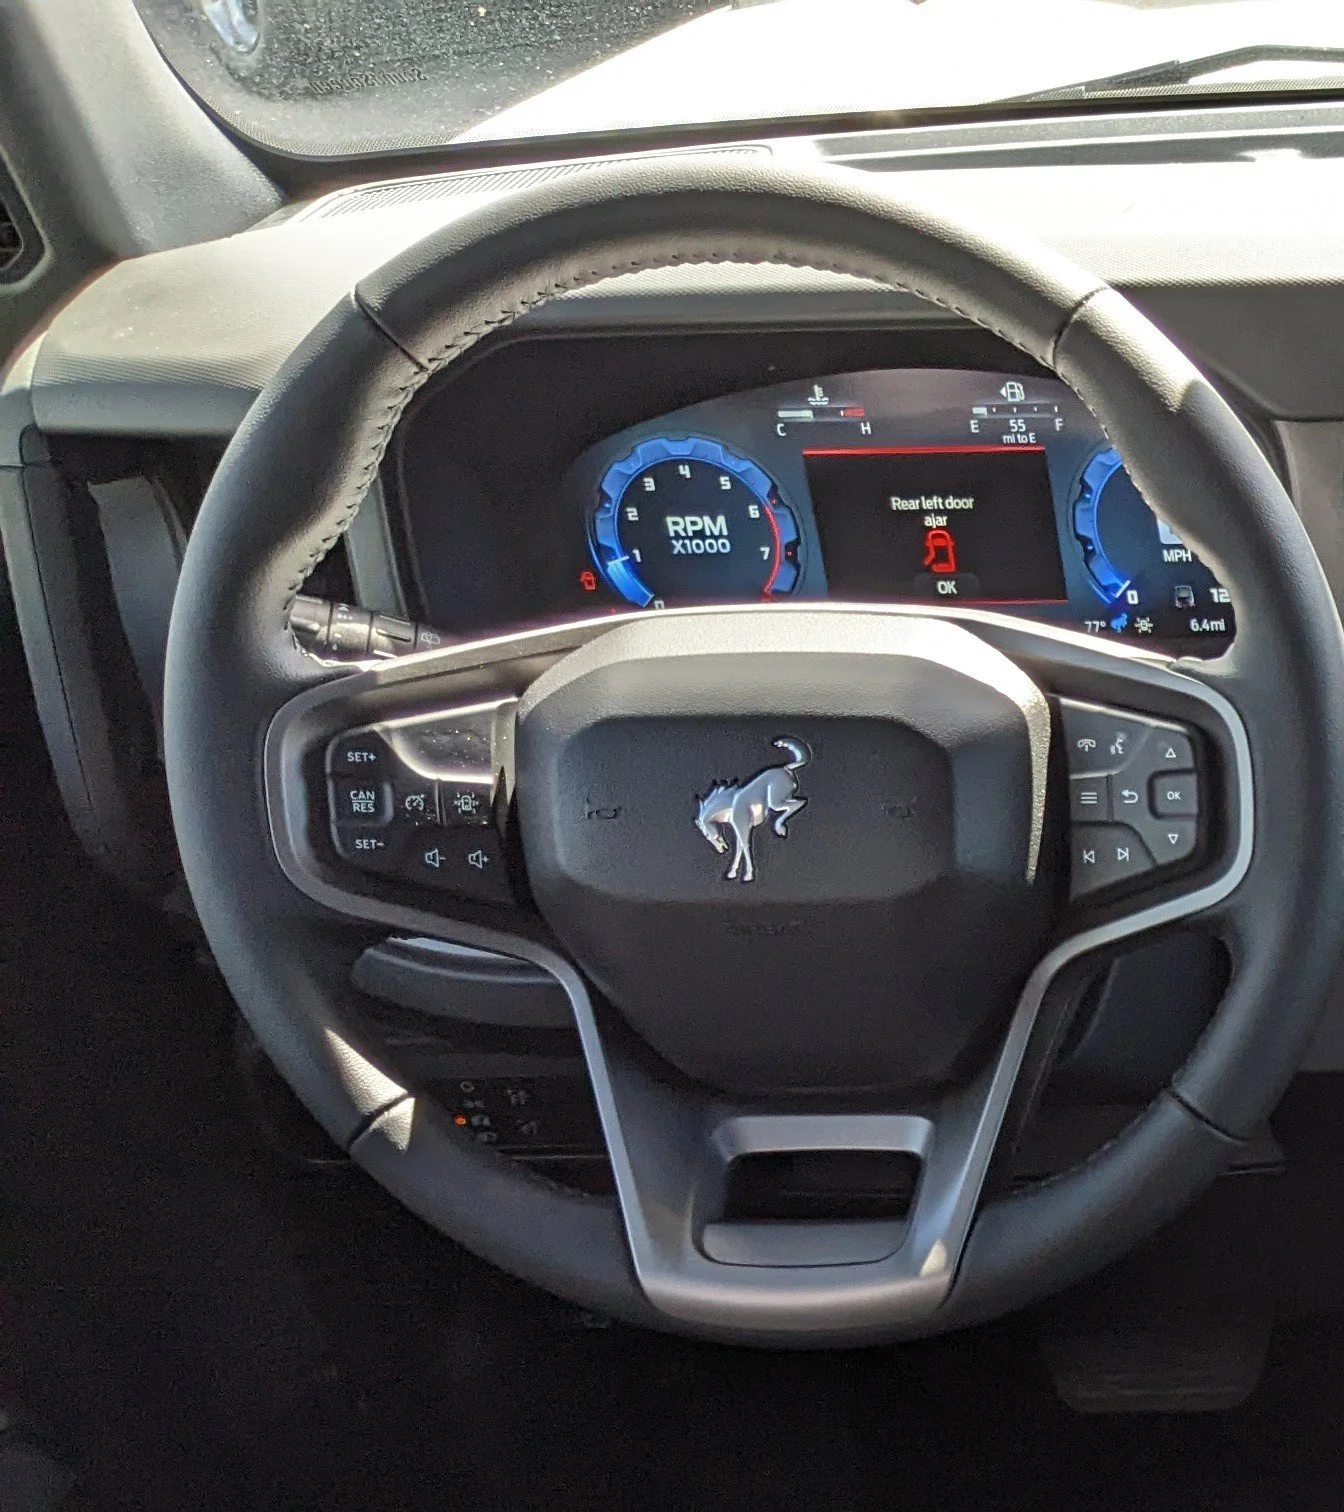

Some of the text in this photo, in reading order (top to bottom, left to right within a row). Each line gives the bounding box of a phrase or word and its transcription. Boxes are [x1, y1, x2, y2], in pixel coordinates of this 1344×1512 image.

[775, 423, 787, 437] C
[860, 422, 872, 435] H
[970, 420, 980, 433] E
[1009, 419, 1026, 432] 55
[1055, 418, 1063, 431] F
[678, 464, 691, 479] 4
[644, 477, 655, 492] 3
[720, 476, 732, 490] 5
[891, 495, 975, 511] Rear left door
[626, 507, 639, 521] 2
[748, 505, 760, 519] 6
[666, 515, 728, 537] RPM
[924, 514, 948, 528] ajar
[672, 539, 730, 555] X1000
[760, 546, 770, 560] 7
[632, 550, 642, 563] 1
[1163, 550, 1192, 562] MPH
[937, 580, 958, 594] OK
[1126, 590, 1139, 604] 0
[347, 752, 376, 762] SET+
[350, 790, 375, 800] CAN
[1167, 791, 1181, 800] OK
[352, 803, 375, 813] RES
